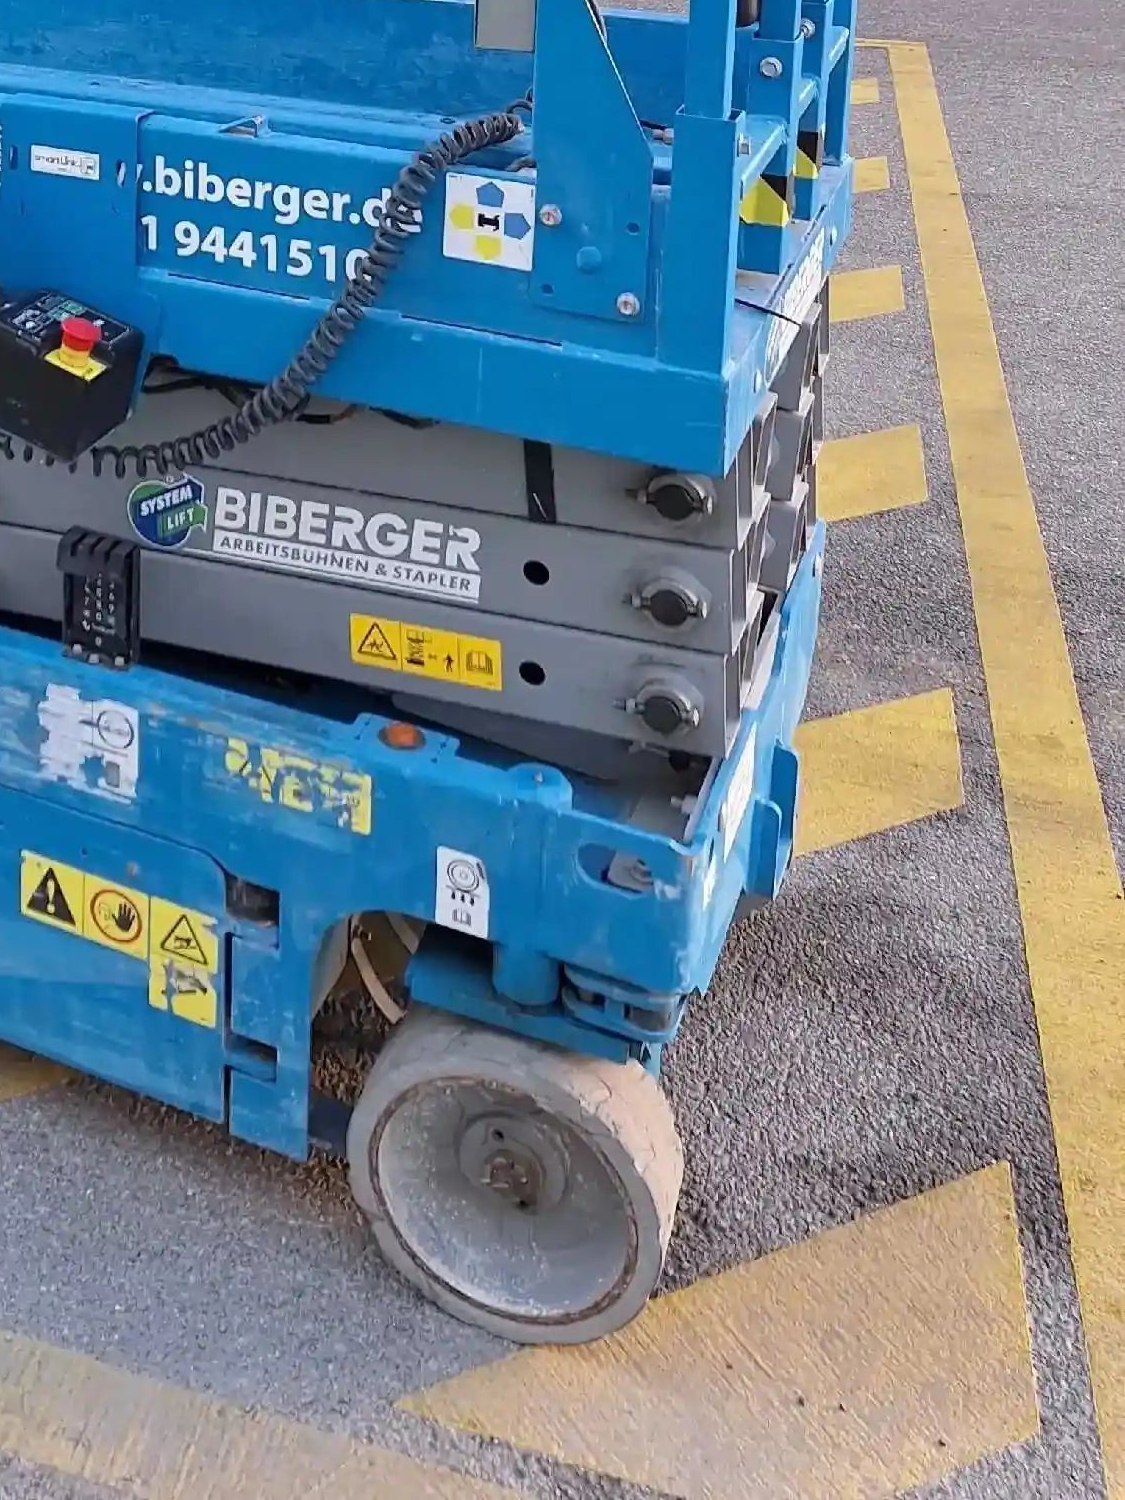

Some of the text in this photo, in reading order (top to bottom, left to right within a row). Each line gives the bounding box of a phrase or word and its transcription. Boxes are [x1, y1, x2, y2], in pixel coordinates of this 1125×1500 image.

[139, 484, 193, 517] SYSTEM
[167, 508, 195, 531] LIFT
[214, 486, 480, 572] BIBERGER
[375, 563, 388, 577] &
[392, 565, 472, 592] STAPLER
